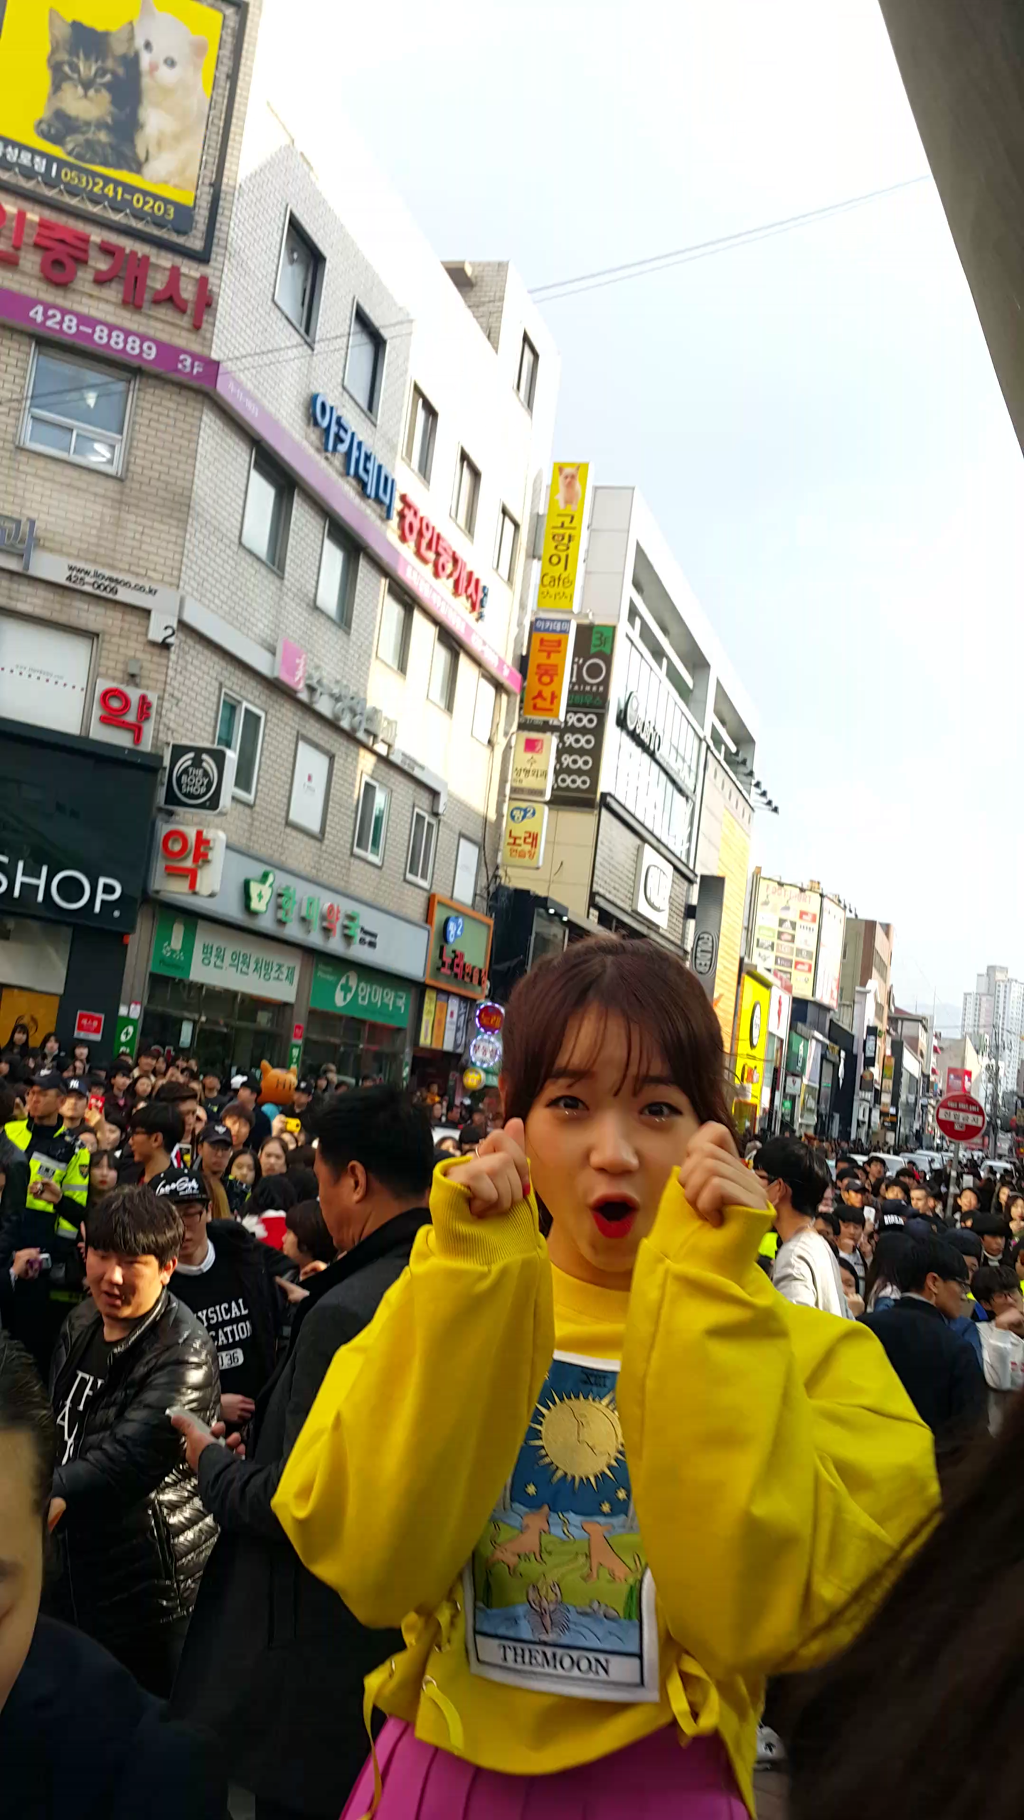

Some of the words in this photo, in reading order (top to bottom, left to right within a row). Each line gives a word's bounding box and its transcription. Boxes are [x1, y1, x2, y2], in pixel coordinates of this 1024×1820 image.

[61, 167, 175, 220] 053)241-0203
[29, 304, 157, 360] 428-8889
[177, 354, 204, 376] 3F
[312, 392, 397, 520] 아카데미
[399, 493, 484, 614] 공인중개사
[548, 513, 577, 572] 고양이
[65, 574, 119, 597] 425-0009
[160, 625, 176, 650] 2
[531, 637, 562, 712] 부동산
[99, 687, 152, 745] 약
[181, 774, 209, 787] BODY
[181, 784, 207, 796] SHOP
[188, 766, 204, 776] THE
[162, 829, 211, 891] 약
[506, 829, 539, 849] 노래
[278, 885, 360, 946] 한미약국
[229, 949, 252, 976] 의원
[253, 957, 296, 987] 처방조제
[358, 981, 406, 1014] 한미약국
